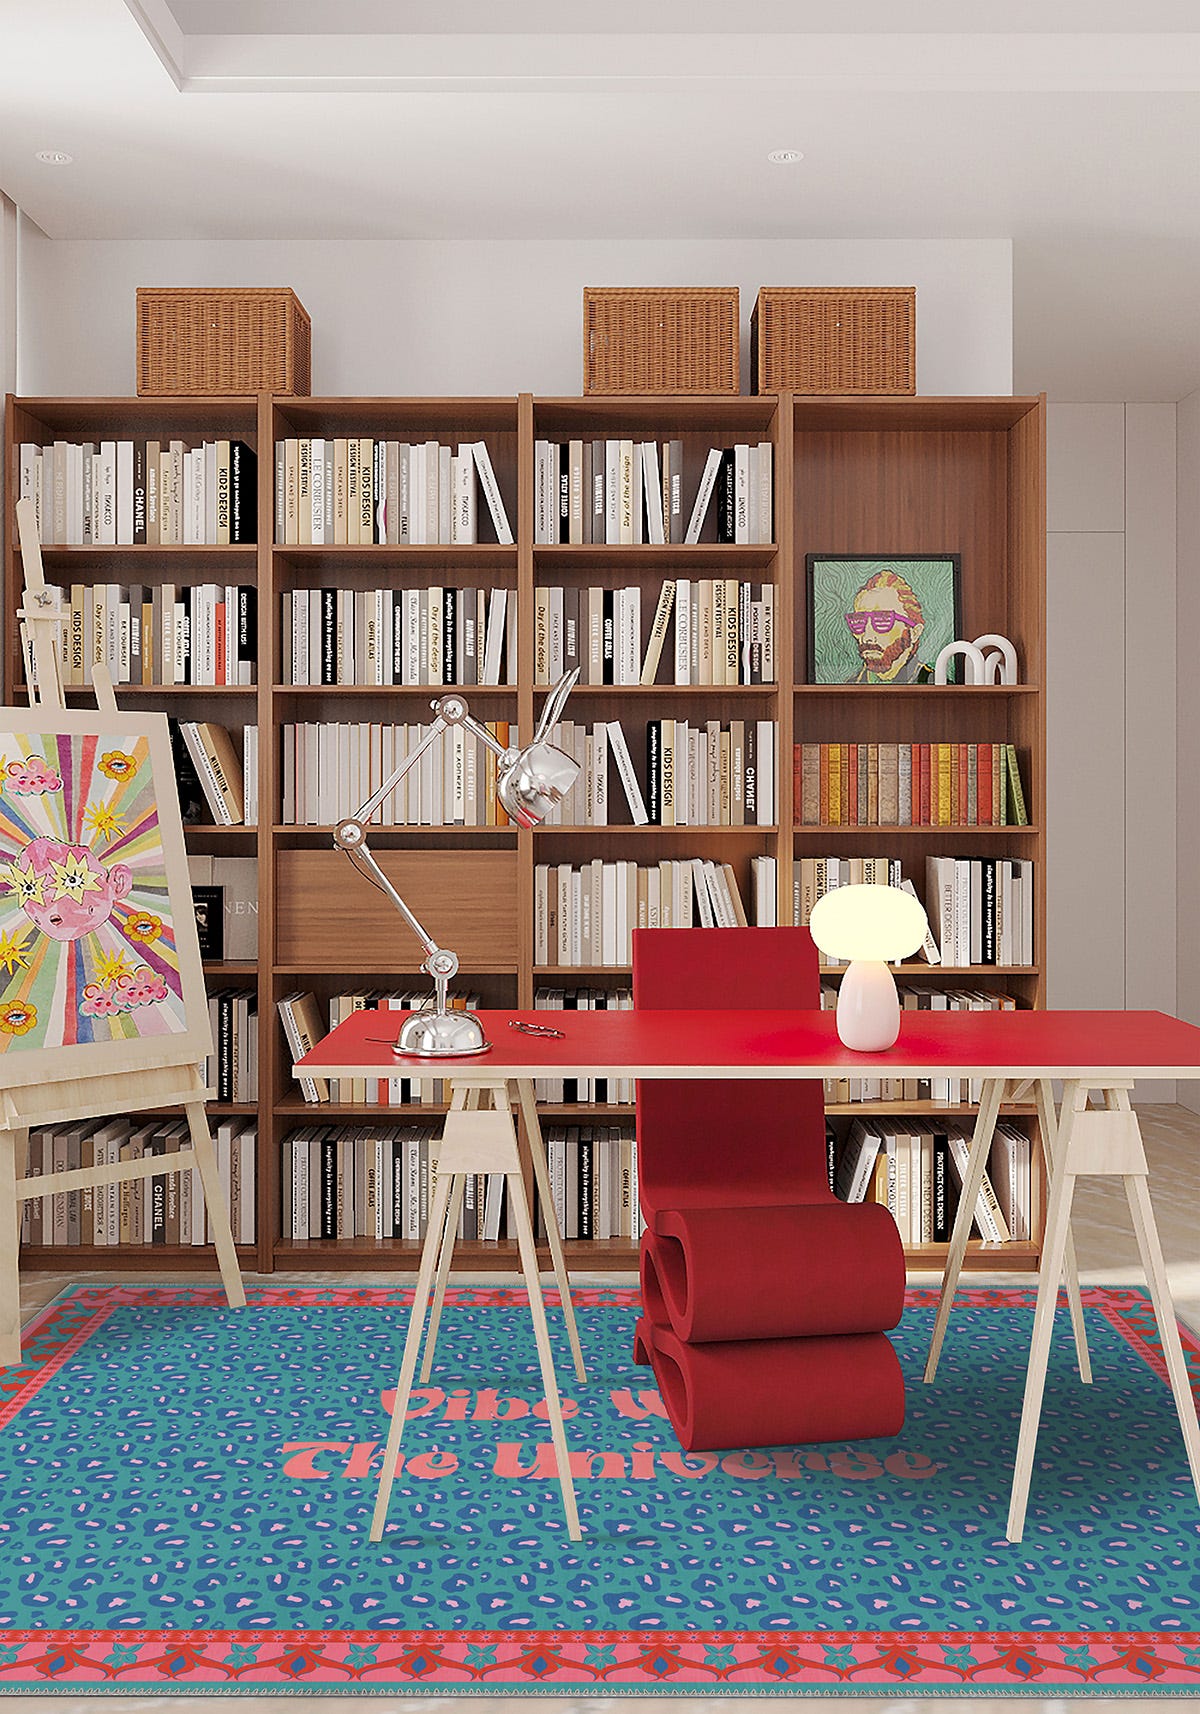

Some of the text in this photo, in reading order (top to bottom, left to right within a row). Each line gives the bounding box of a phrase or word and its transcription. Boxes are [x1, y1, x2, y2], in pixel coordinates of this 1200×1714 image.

[135, 488, 144, 533] CHANEL
[313, 458, 322, 531] LE CORBUSIER
[362, 466, 371, 526] KIDS DESIGN
[623, 500, 630, 510] of
[95, 604, 104, 620] Day
[97, 620, 104, 630] of
[121, 620, 127, 630] BE
[176, 620, 182, 630] BE
[654, 585, 673, 638] DESIGN FESTIVAL
[764, 606, 771, 615] BE
[73, 610, 82, 669] KIDS DESIGN
[431, 606, 440, 673] Day of the design
[537, 606, 546, 673] Day of the design
[604, 618, 612, 659] COFFEE ATLAS
[678, 599, 688, 672] LE CORBUSIER
[728, 607, 736, 668] KIDS DESIGN
[664, 747, 672, 806] KIDS DESIGN
[944, 884, 952, 944] BETTER DESIGN
[154, 1185, 163, 1230] CHANEL
[622, 1169, 630, 1208] COFFEE ATLAS
[923, 1170, 932, 1239] THE NEXT DESIGN
[110, 1210, 115, 1218] IS
[381, 1389, 580, 1421] Vibe
[283, 1441, 939, 1481] The Universe
